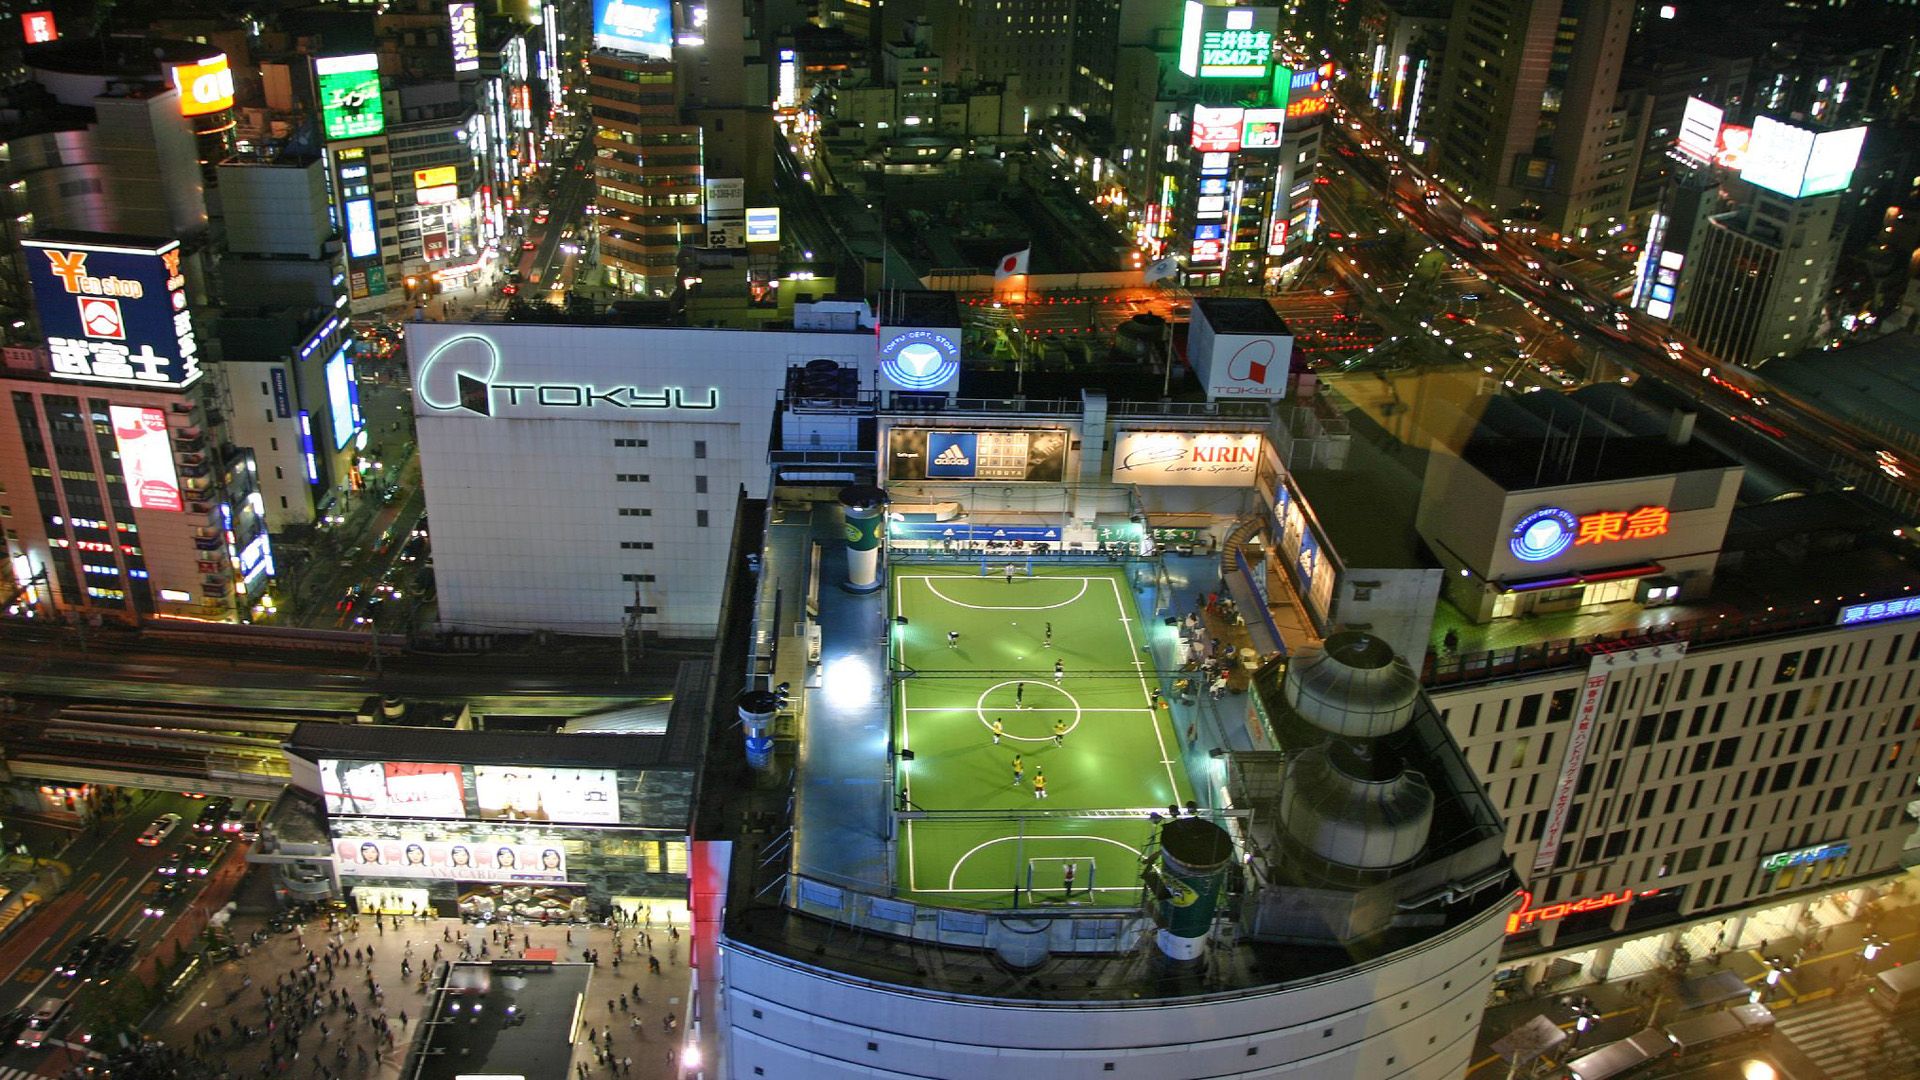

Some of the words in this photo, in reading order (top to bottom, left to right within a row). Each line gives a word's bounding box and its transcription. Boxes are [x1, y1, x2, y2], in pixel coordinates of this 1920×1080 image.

[1203, 31, 1271, 49] 三井住友
[1203, 49, 1270, 65] VISAカード
[1291, 71, 1317, 89] MIKI
[102, 276, 143, 299] shop
[883, 334, 906, 354] TOKYU
[48, 337, 170, 382] 武富士
[491, 384, 717, 409] TOKYU
[1213, 386, 1283, 395] TOKYU
[934, 457, 969, 465] adidas
[1192, 446, 1256, 462] KIRIN
[1165, 464, 1204, 472] Loves
[1574, 505, 1670, 545] 東急
[1519, 888, 1633, 923] TOKYU
